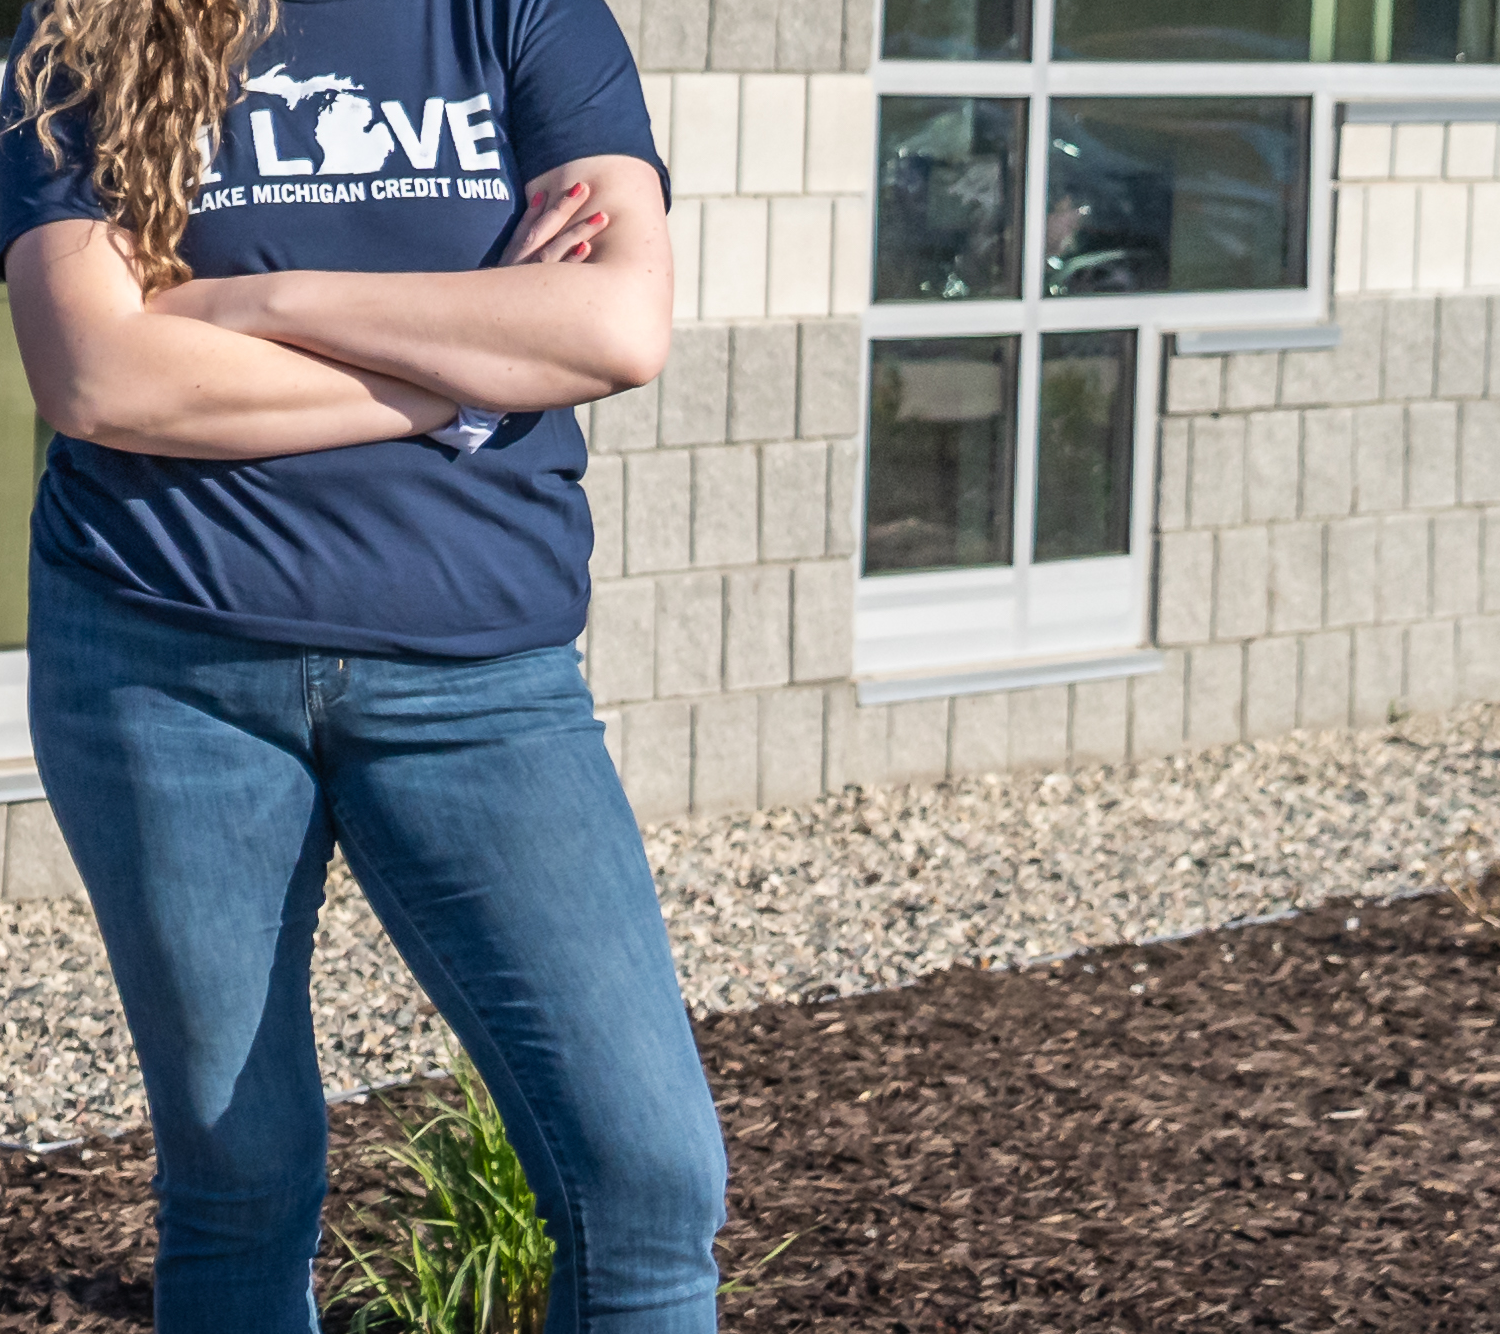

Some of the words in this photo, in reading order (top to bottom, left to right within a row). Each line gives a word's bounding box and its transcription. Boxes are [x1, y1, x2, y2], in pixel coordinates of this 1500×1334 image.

[187, 185, 247, 215] LAKE
[252, 181, 366, 204] MICHIGAN
[370, 177, 451, 200] CREDIT
